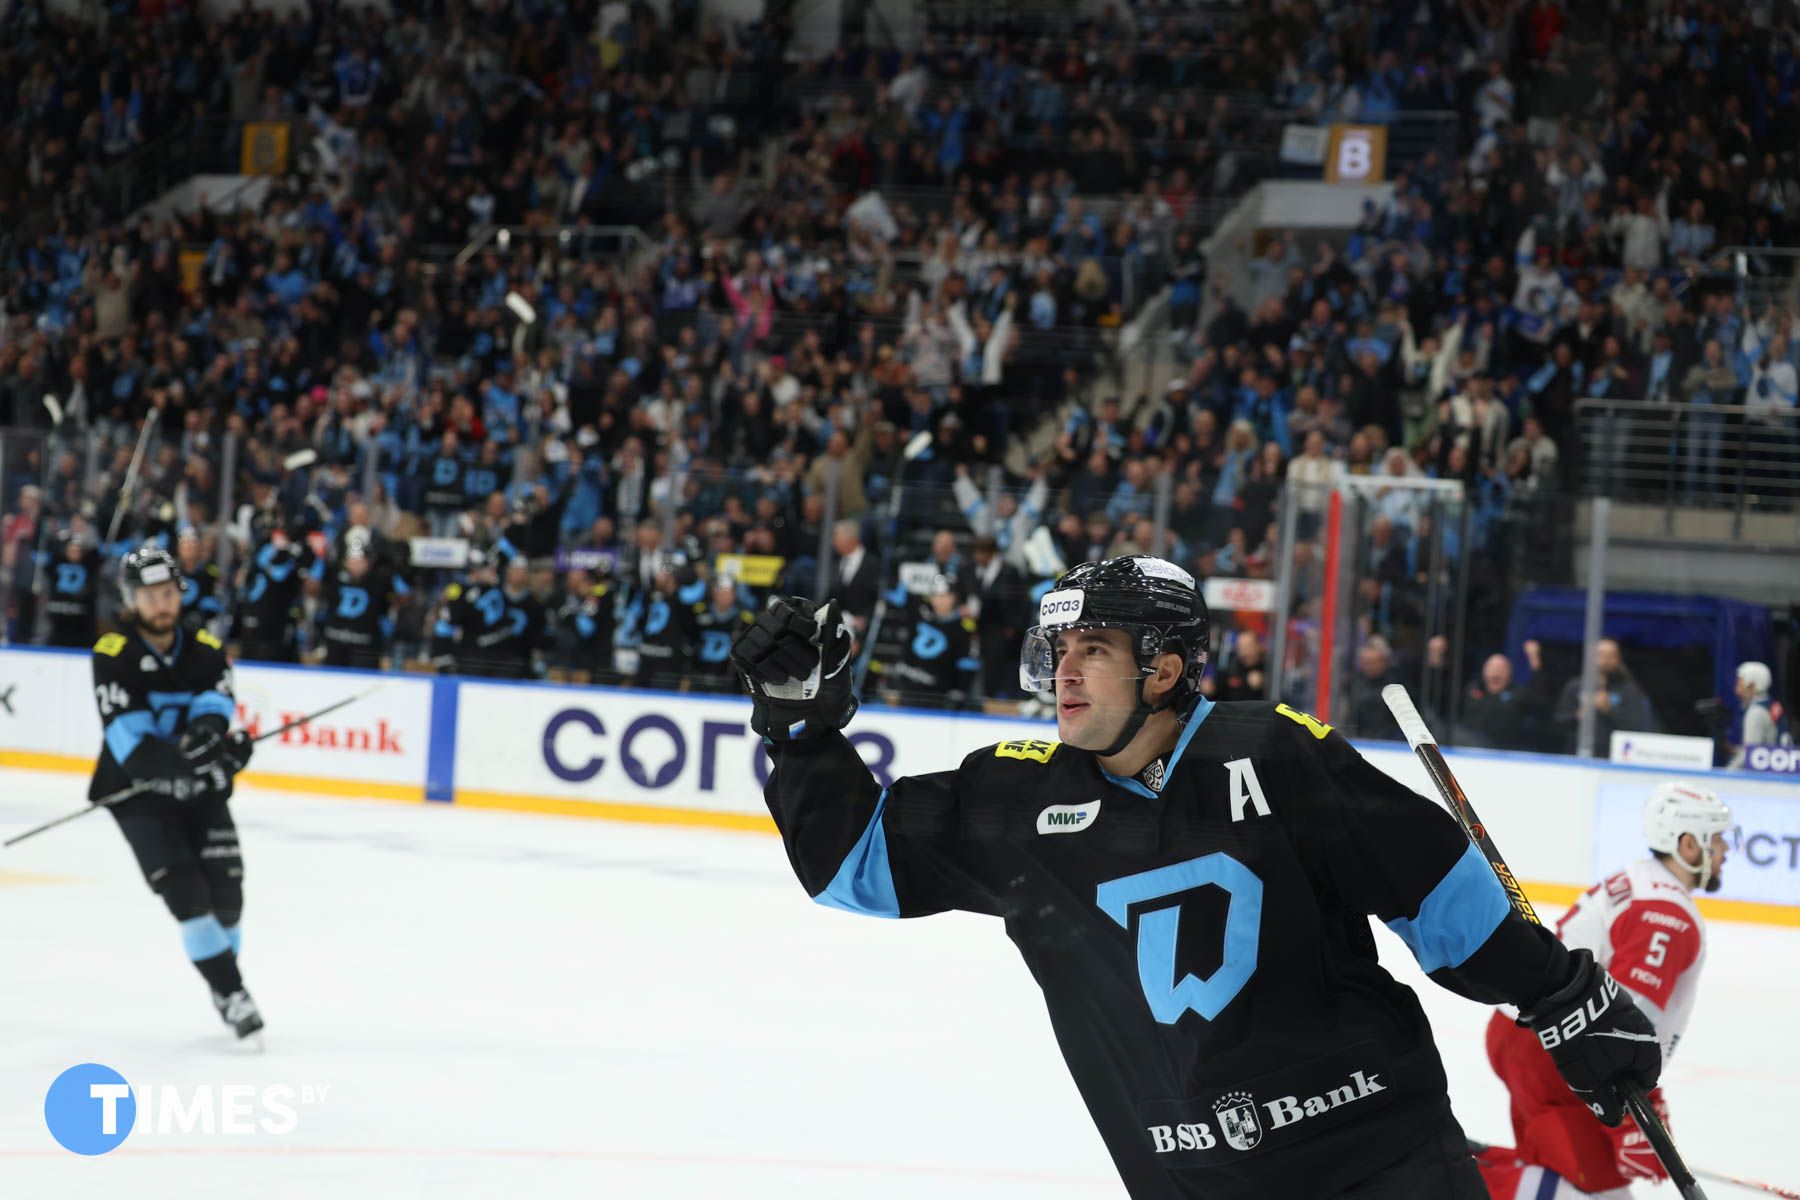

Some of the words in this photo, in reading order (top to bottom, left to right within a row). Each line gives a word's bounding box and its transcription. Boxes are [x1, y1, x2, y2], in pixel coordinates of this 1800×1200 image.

[1041, 599, 1081, 616] согаз
[277, 711, 404, 756] Bank
[1223, 757, 1271, 822] A
[1047, 811, 1088, 826] МИР
[1644, 931, 1671, 968] 5
[1538, 970, 1619, 1050] BAUE
[1147, 1121, 1217, 1153] BSB
[1262, 1069, 1387, 1130] Bank
